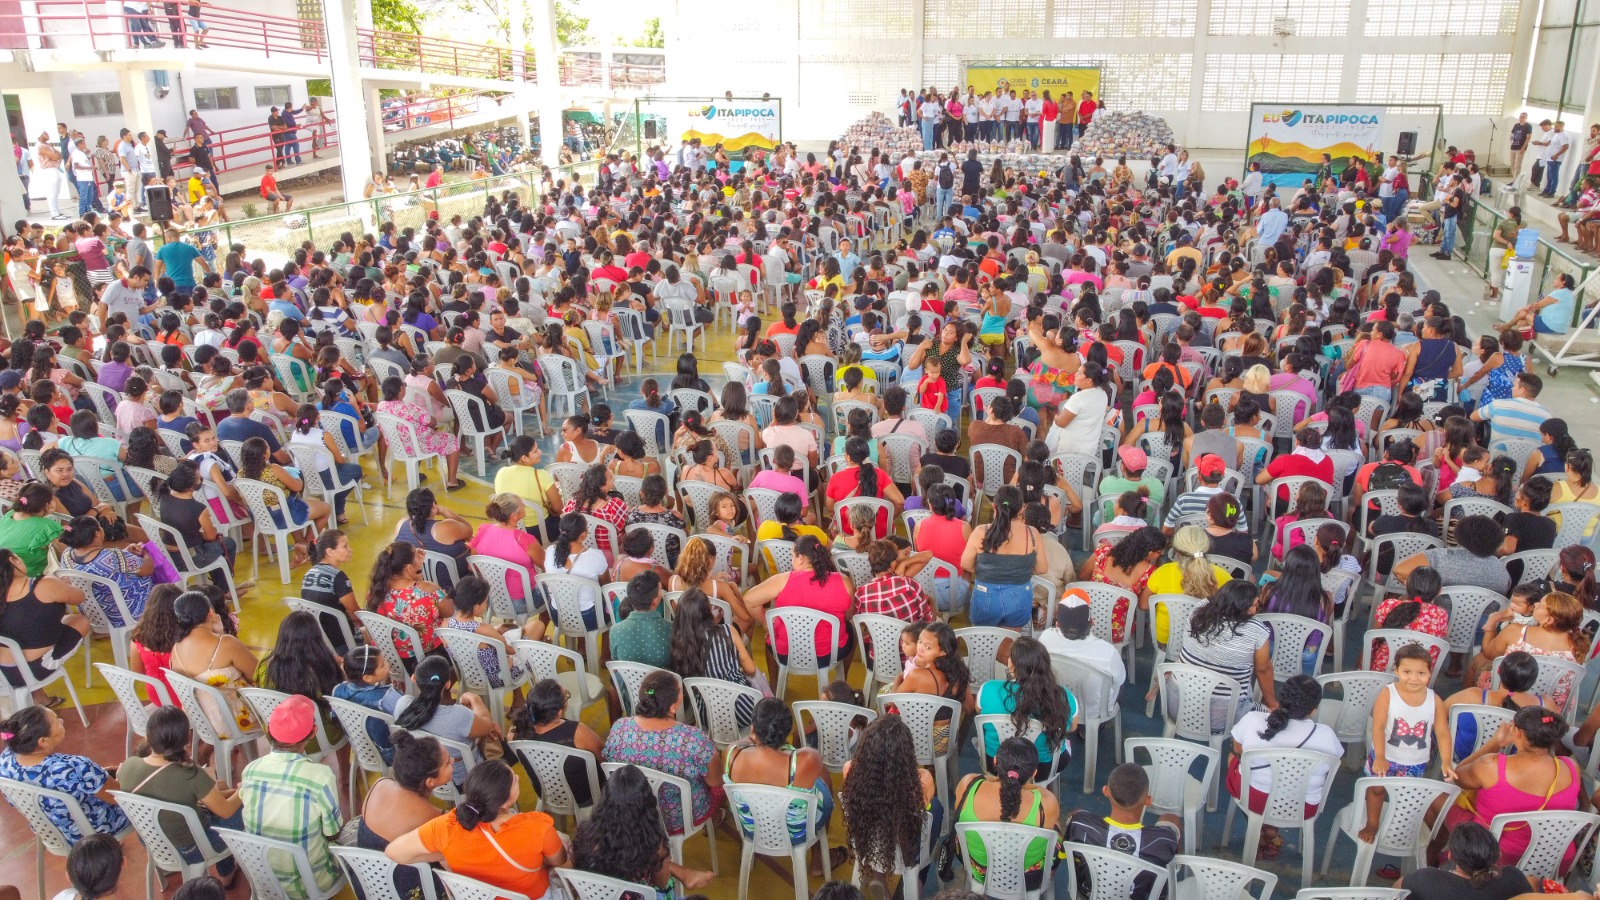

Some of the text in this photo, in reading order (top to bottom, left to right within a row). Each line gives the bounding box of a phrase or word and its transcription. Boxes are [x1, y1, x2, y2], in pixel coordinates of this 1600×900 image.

[688, 108, 775, 117] EU ITAPIPOCA
[1263, 113, 1379, 125] EU ITAPIPOCA
